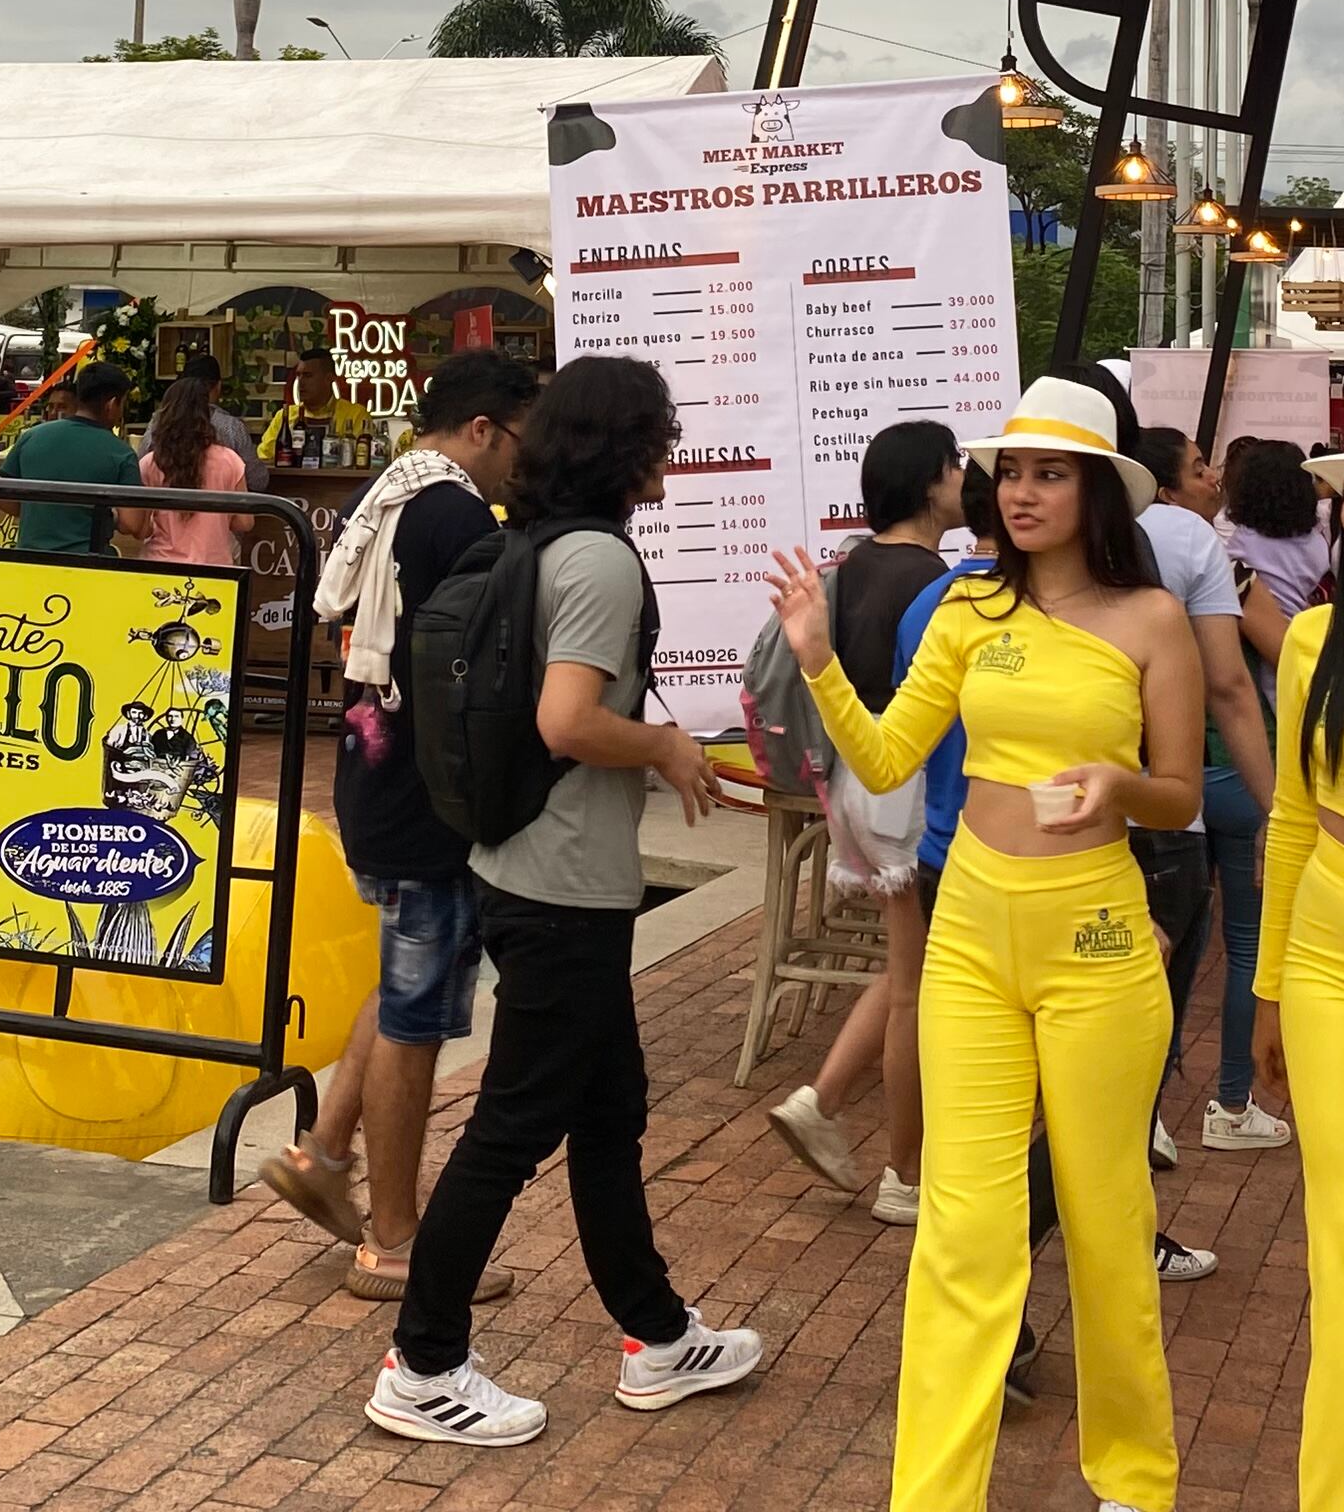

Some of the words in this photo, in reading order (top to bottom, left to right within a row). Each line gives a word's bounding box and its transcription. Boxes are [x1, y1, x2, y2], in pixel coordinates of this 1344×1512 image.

[703, 147, 757, 164] MEAT
[762, 141, 844, 160] MARKET
[750, 161, 808, 176] Express
[576, 185, 755, 218] MAESTROS
[763, 170, 983, 205] PARRILLEROS
[579, 242, 683, 269] ENTRADAS
[811, 255, 890, 280] CORTES
[708, 281, 753, 293] 12.000
[572, 289, 623, 302] Morcilla
[948, 295, 995, 307] 39.000
[709, 303, 754, 315] 15.000
[806, 303, 837, 317] Baby
[843, 300, 872, 313] beef
[572, 313, 620, 325] Chorizo
[950, 318, 996, 330] 37.000
[329, 308, 406, 354] RON
[710, 328, 755, 341] 19.500
[806, 325, 874, 338] Churrasco
[574, 336, 611, 349] Arepa
[616, 335, 638, 346] con
[643, 332, 681, 347] queso
[809, 352, 846, 364] Punta
[852, 350, 867, 362] de
[872, 349, 904, 360] anca
[952, 344, 998, 356] 39.000
[711, 352, 757, 365] 29.000
[954, 371, 1000, 383] 44.000
[810, 380, 830, 392] Rib
[835, 381, 858, 393] eye
[864, 377, 883, 390] sin
[888, 376, 928, 389] hueso
[714, 393, 759, 406] 32.000
[955, 400, 1002, 412] 28.000
[812, 407, 868, 421] Pechuga
[814, 433, 873, 446] Costillas
[667, 445, 756, 470] RGUESAS
[815, 452, 830, 462] en
[835, 450, 859, 463] bbq
[720, 494, 765, 507] 14.000
[639, 522, 670, 537] pollo
[721, 518, 767, 530] 14.000
[723, 543, 768, 555] 19.000
[282, 608, 294, 622] lo
[653, 649, 738, 664] 105140926
[655, 673, 742, 686] RKET_RESTAU
[42, 823, 147, 843] PIONERO
[51, 843, 69, 853] DE
[71, 844, 98, 854] LOS
[16, 845, 175, 879] Aguardientes
[94, 881, 132, 897] 1885
